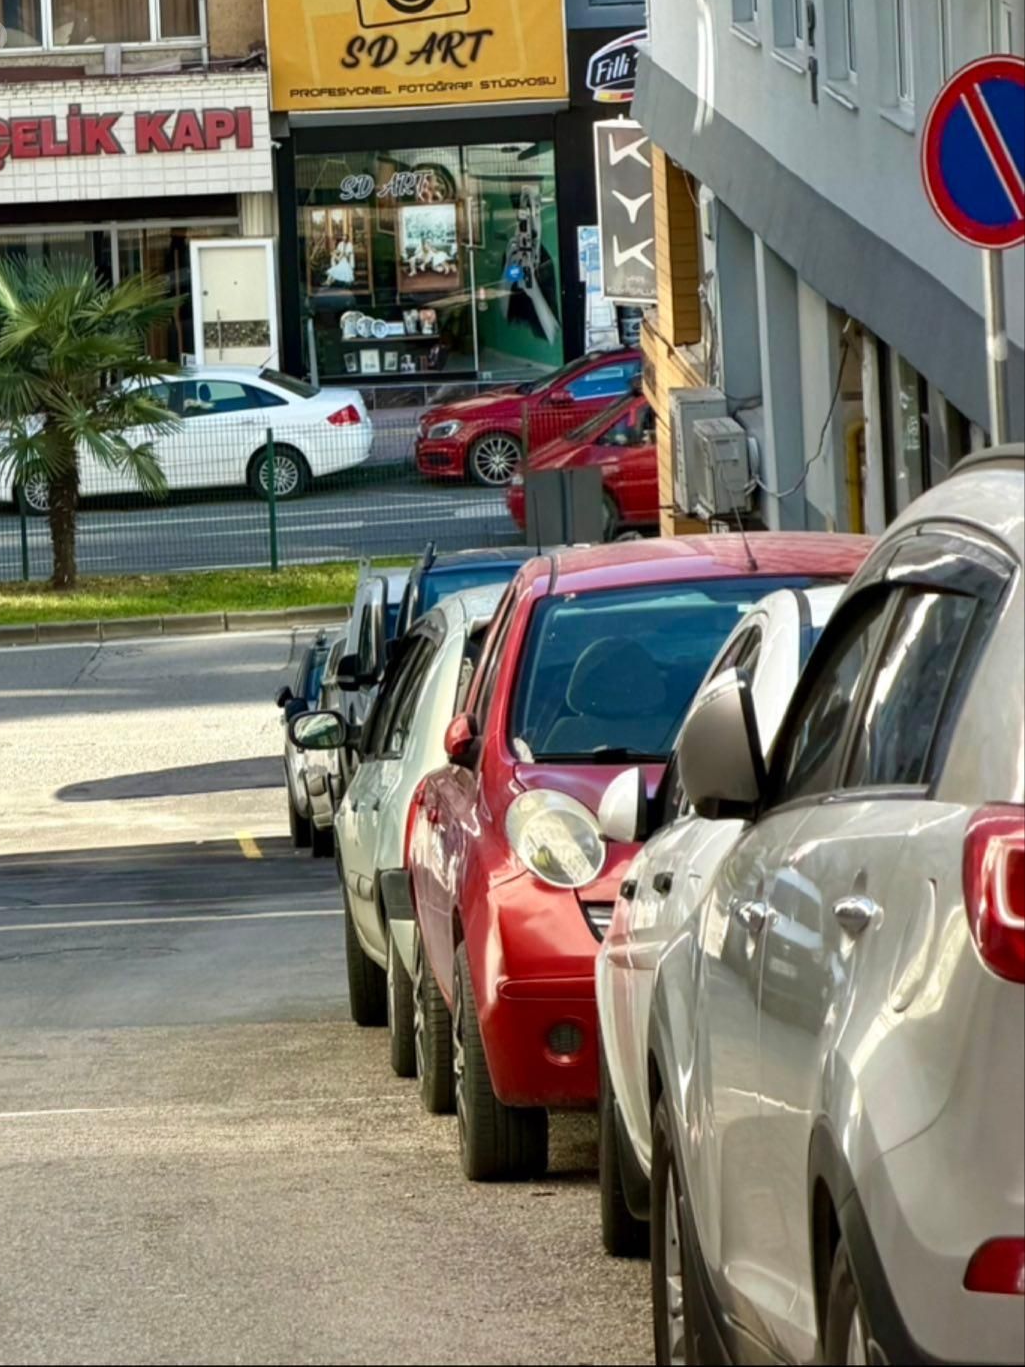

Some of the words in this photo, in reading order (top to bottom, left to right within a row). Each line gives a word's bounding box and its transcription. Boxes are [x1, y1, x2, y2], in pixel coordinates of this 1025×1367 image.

[340, 34, 399, 69] SD
[404, 28, 495, 69] ART
[595, 52, 631, 84] Filli
[289, 85, 392, 98] PROFESYONEL
[398, 80, 473, 94] FOTOĞRAF
[479, 76, 557, 90] STÜDYOSU
[134, 106, 254, 154] KAPI
